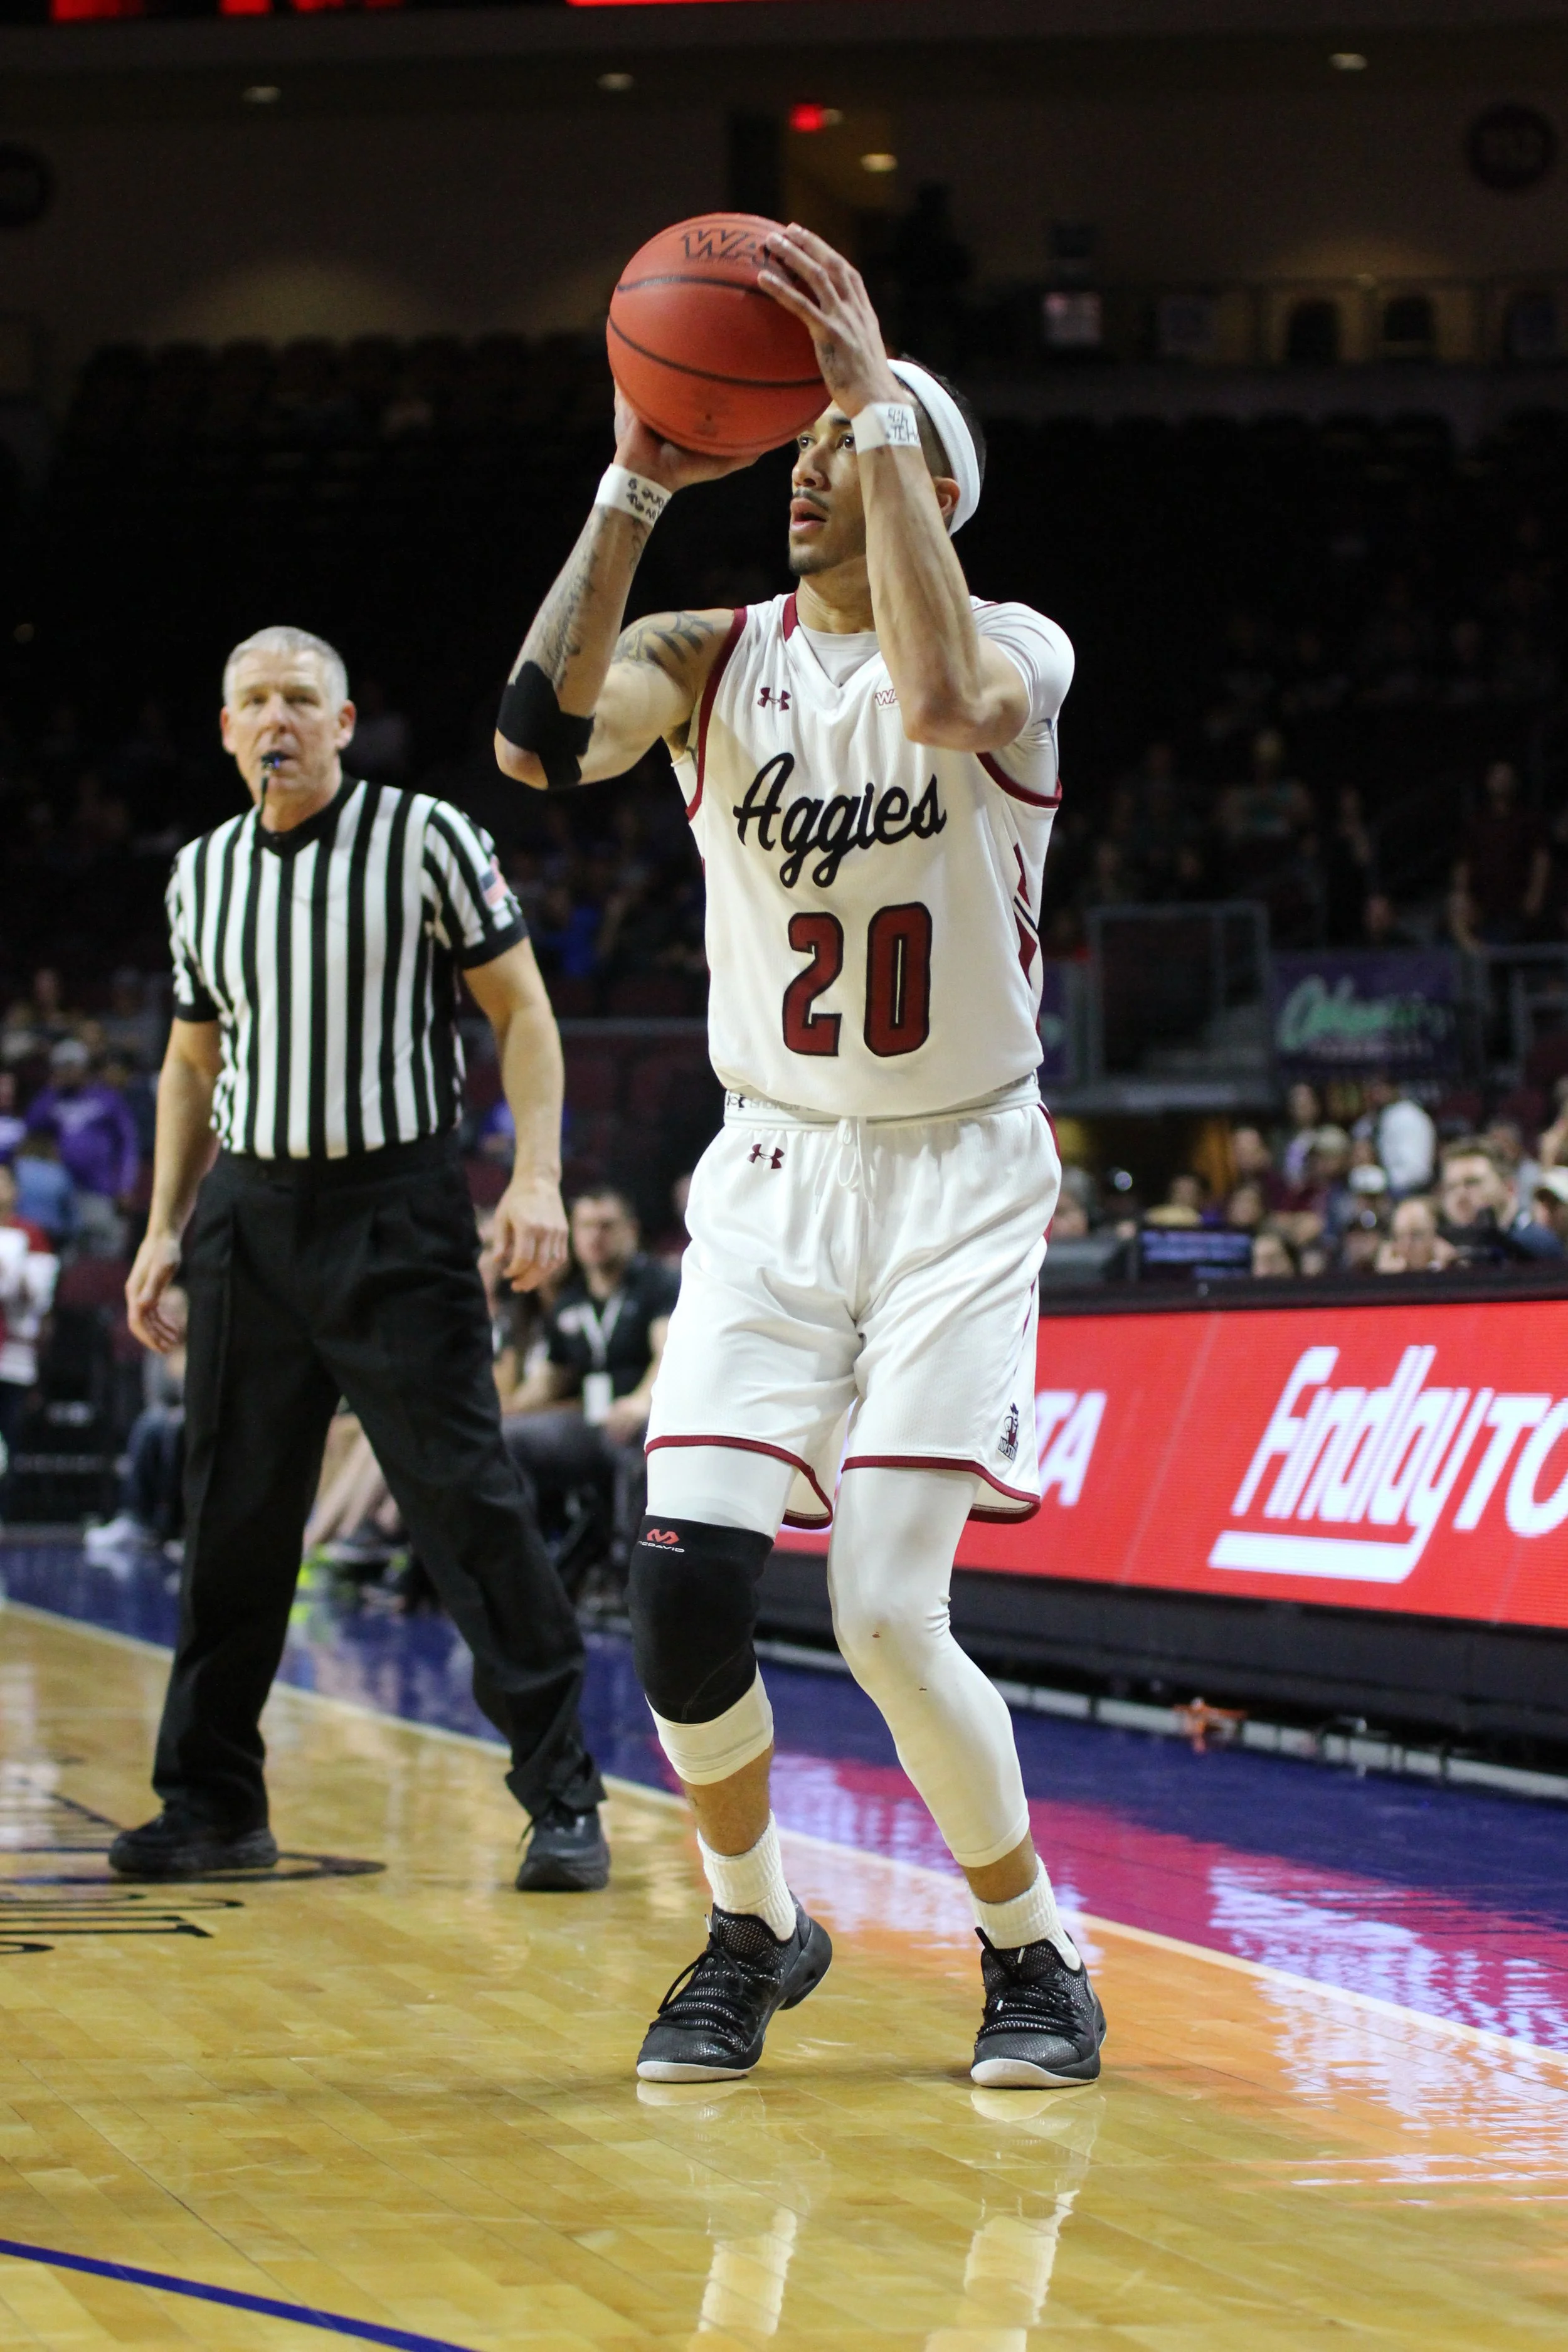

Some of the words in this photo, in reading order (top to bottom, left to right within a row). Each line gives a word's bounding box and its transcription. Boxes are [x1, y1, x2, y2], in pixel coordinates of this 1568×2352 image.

[681, 230, 770, 266] WA
[733, 753, 947, 888] Aggies
[782, 901, 933, 1057] 20
